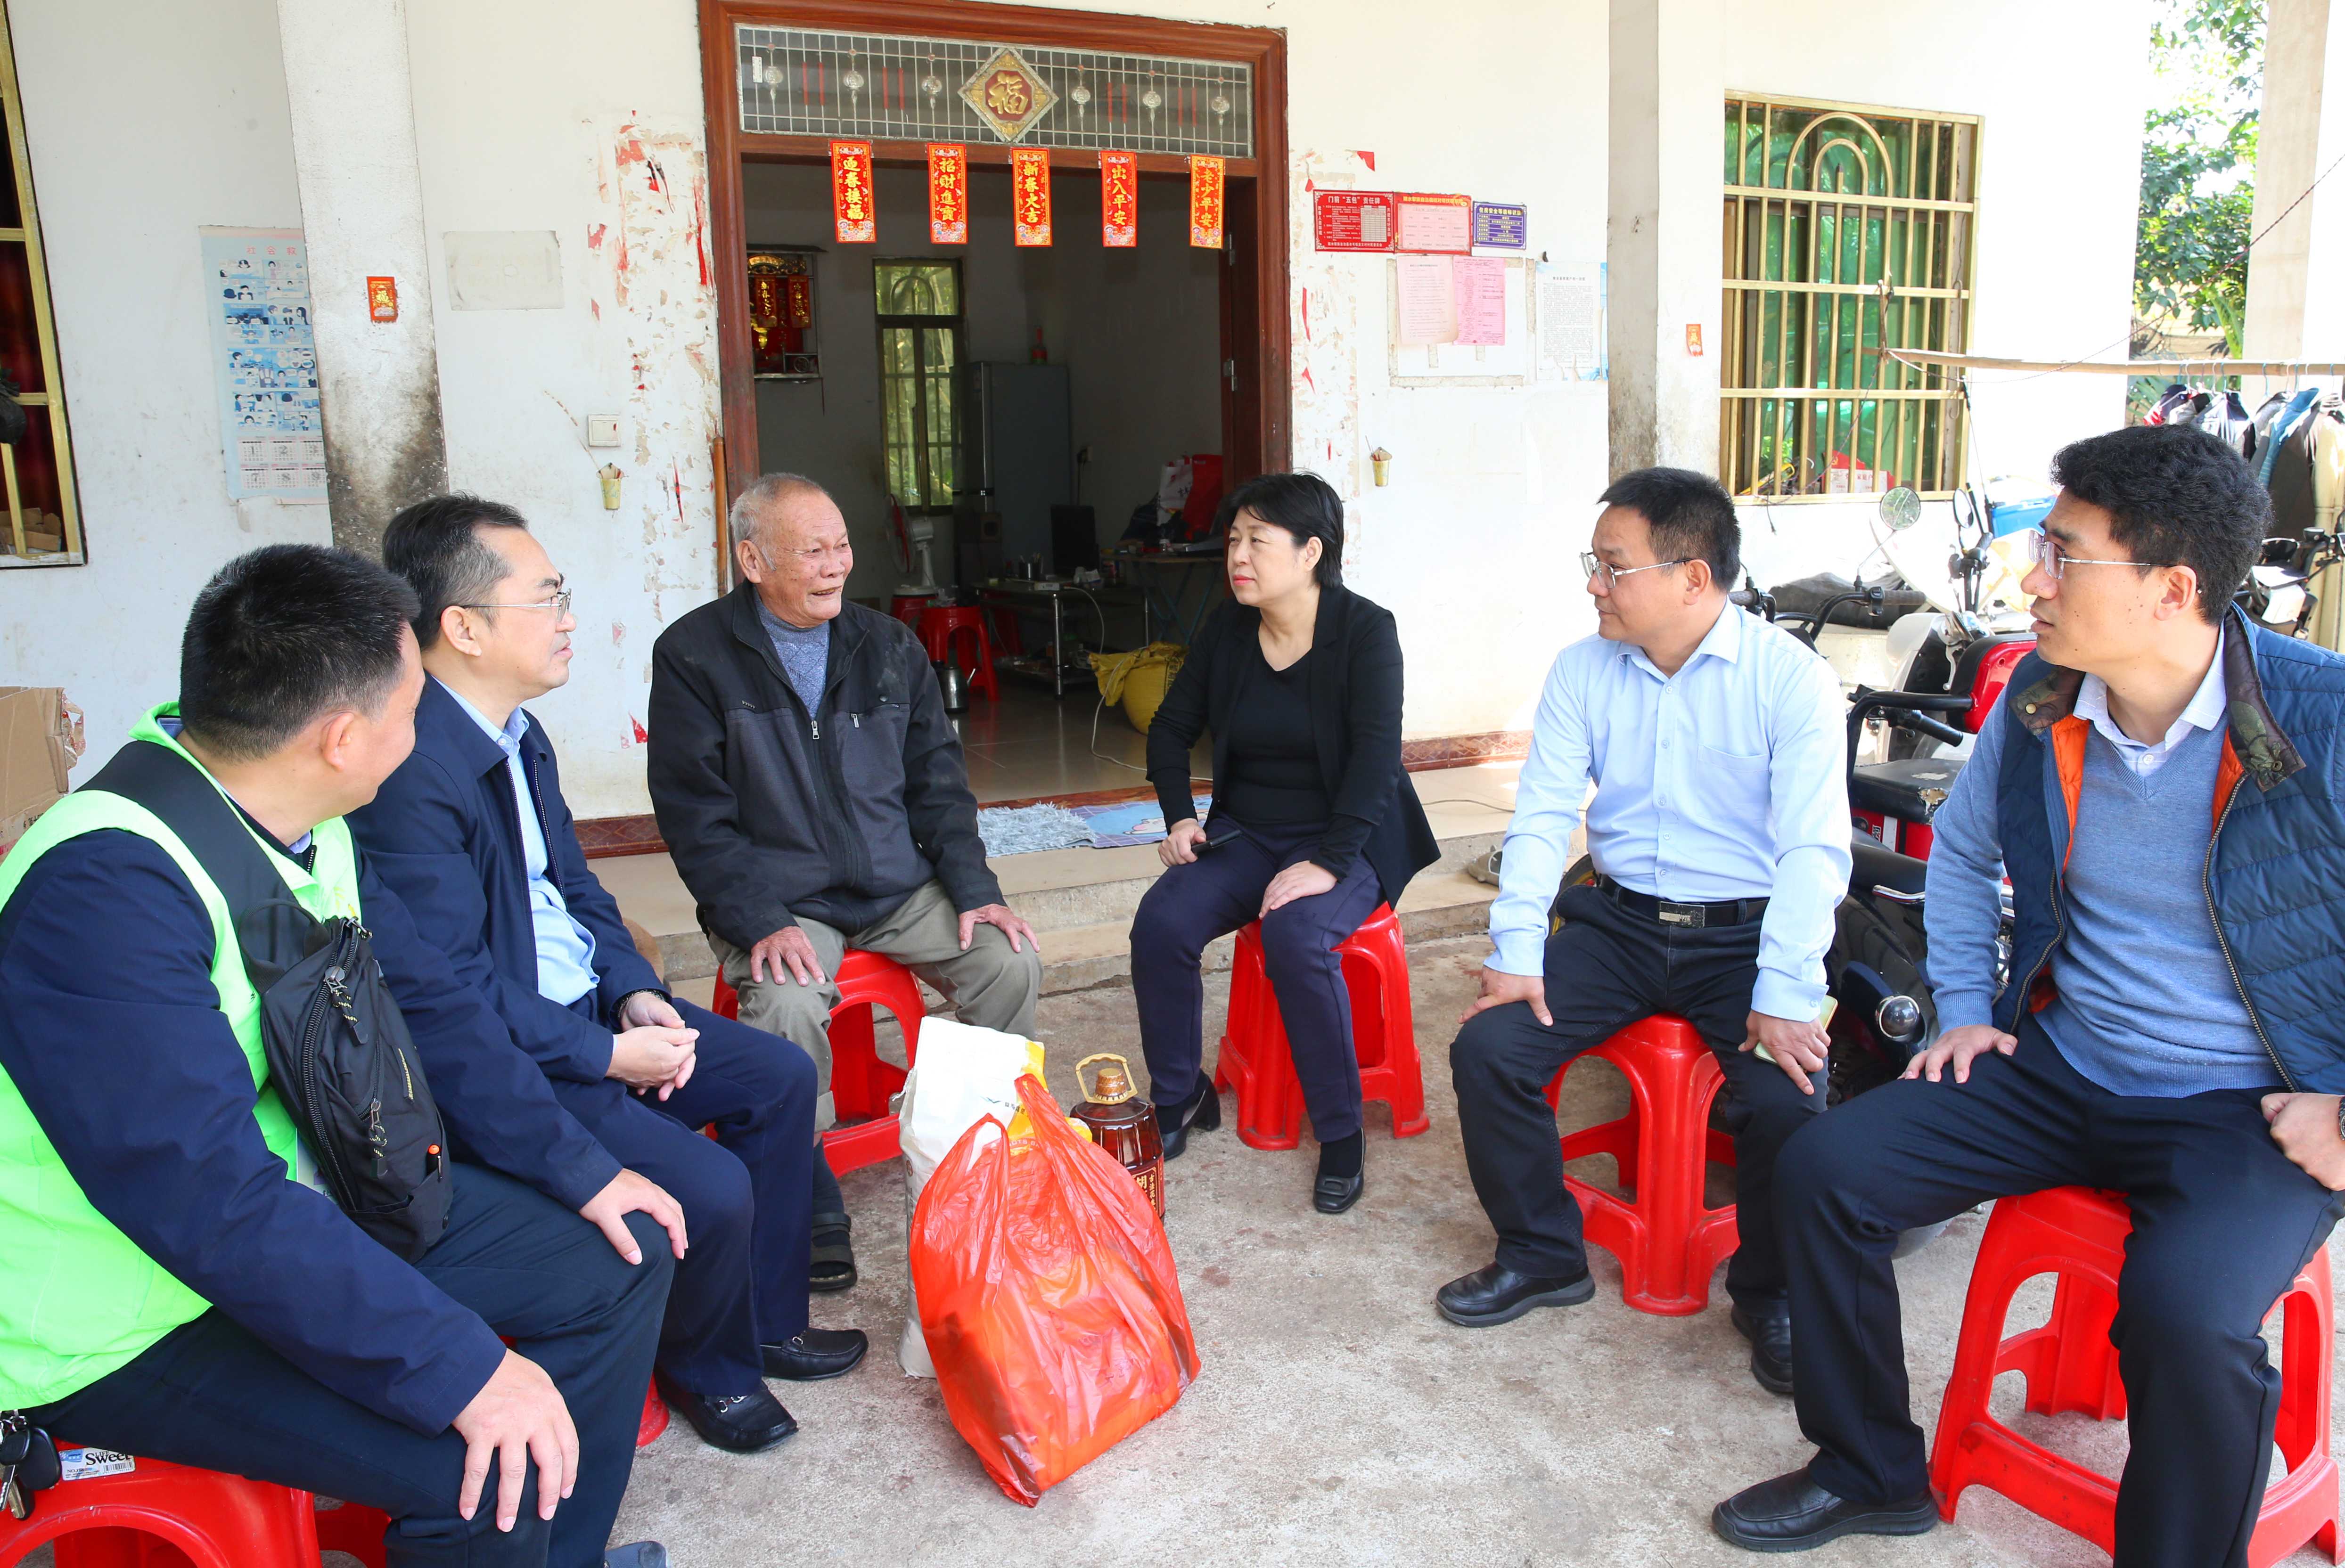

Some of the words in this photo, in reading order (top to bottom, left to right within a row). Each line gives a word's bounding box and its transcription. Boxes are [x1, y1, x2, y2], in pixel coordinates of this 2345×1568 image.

[988, 72, 1028, 114] 福
[843, 156, 864, 220] 迎春接福
[1023, 162, 1041, 223] 新春大吉
[1111, 164, 1127, 226] 出入平安
[1199, 168, 1214, 228] 老少平安
